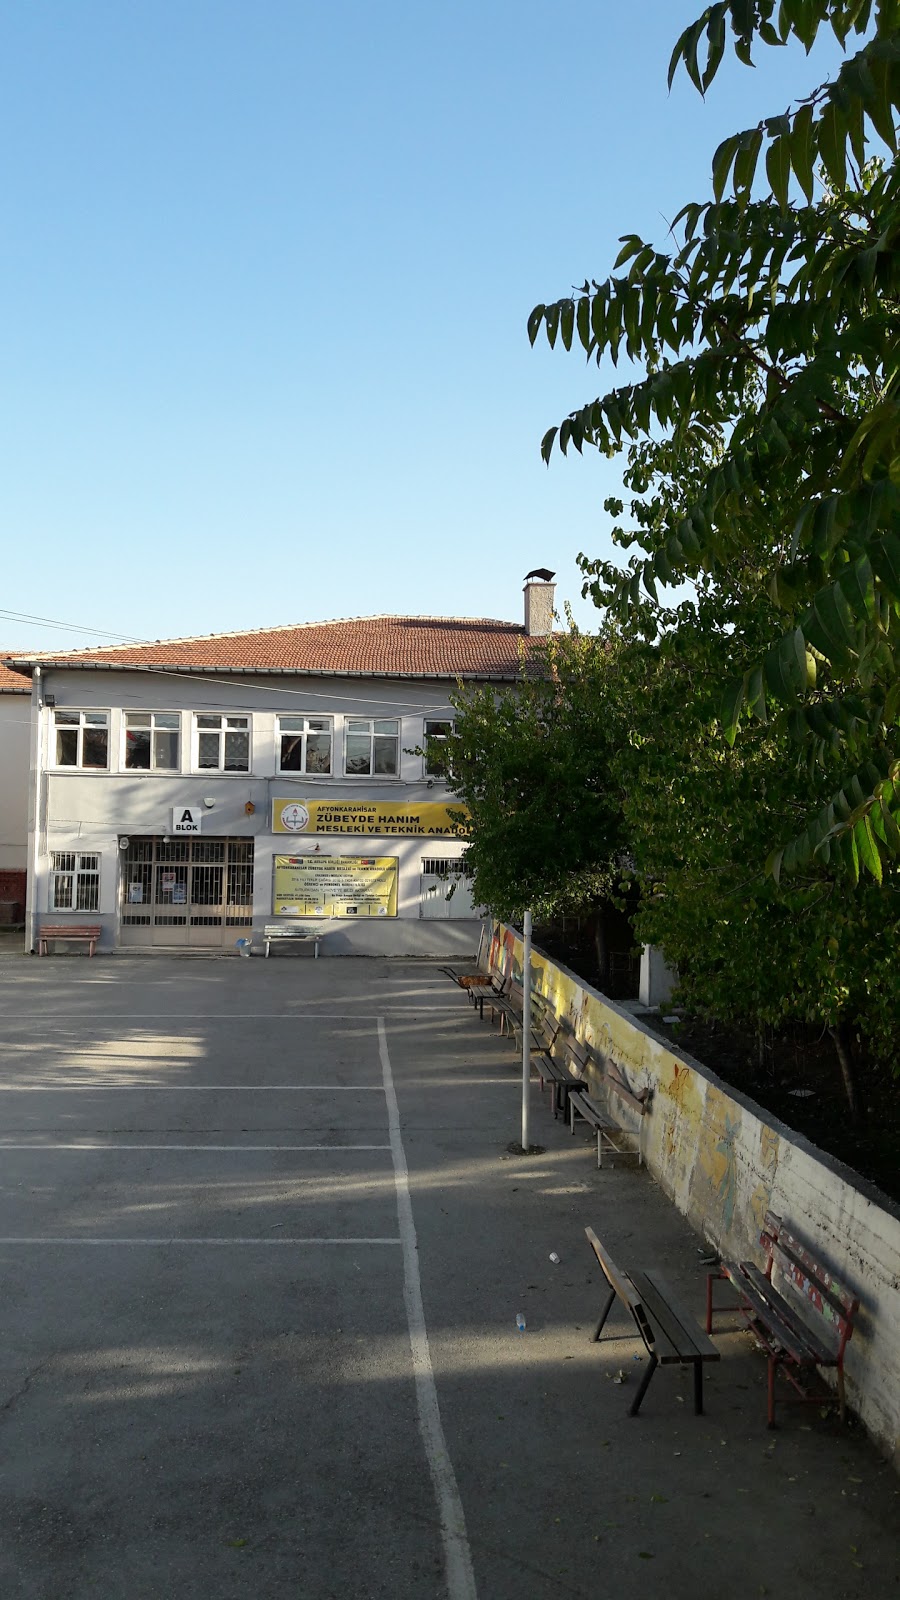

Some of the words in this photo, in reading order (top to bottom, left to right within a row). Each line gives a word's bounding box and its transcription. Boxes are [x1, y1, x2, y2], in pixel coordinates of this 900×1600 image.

[180, 809, 194, 822] A
[316, 813, 375, 823] ZÜBEYDE
[378, 815, 420, 824] HANIM
[316, 824, 365, 833] MESLEKİ
[384, 825, 426, 834] TEKNİK
